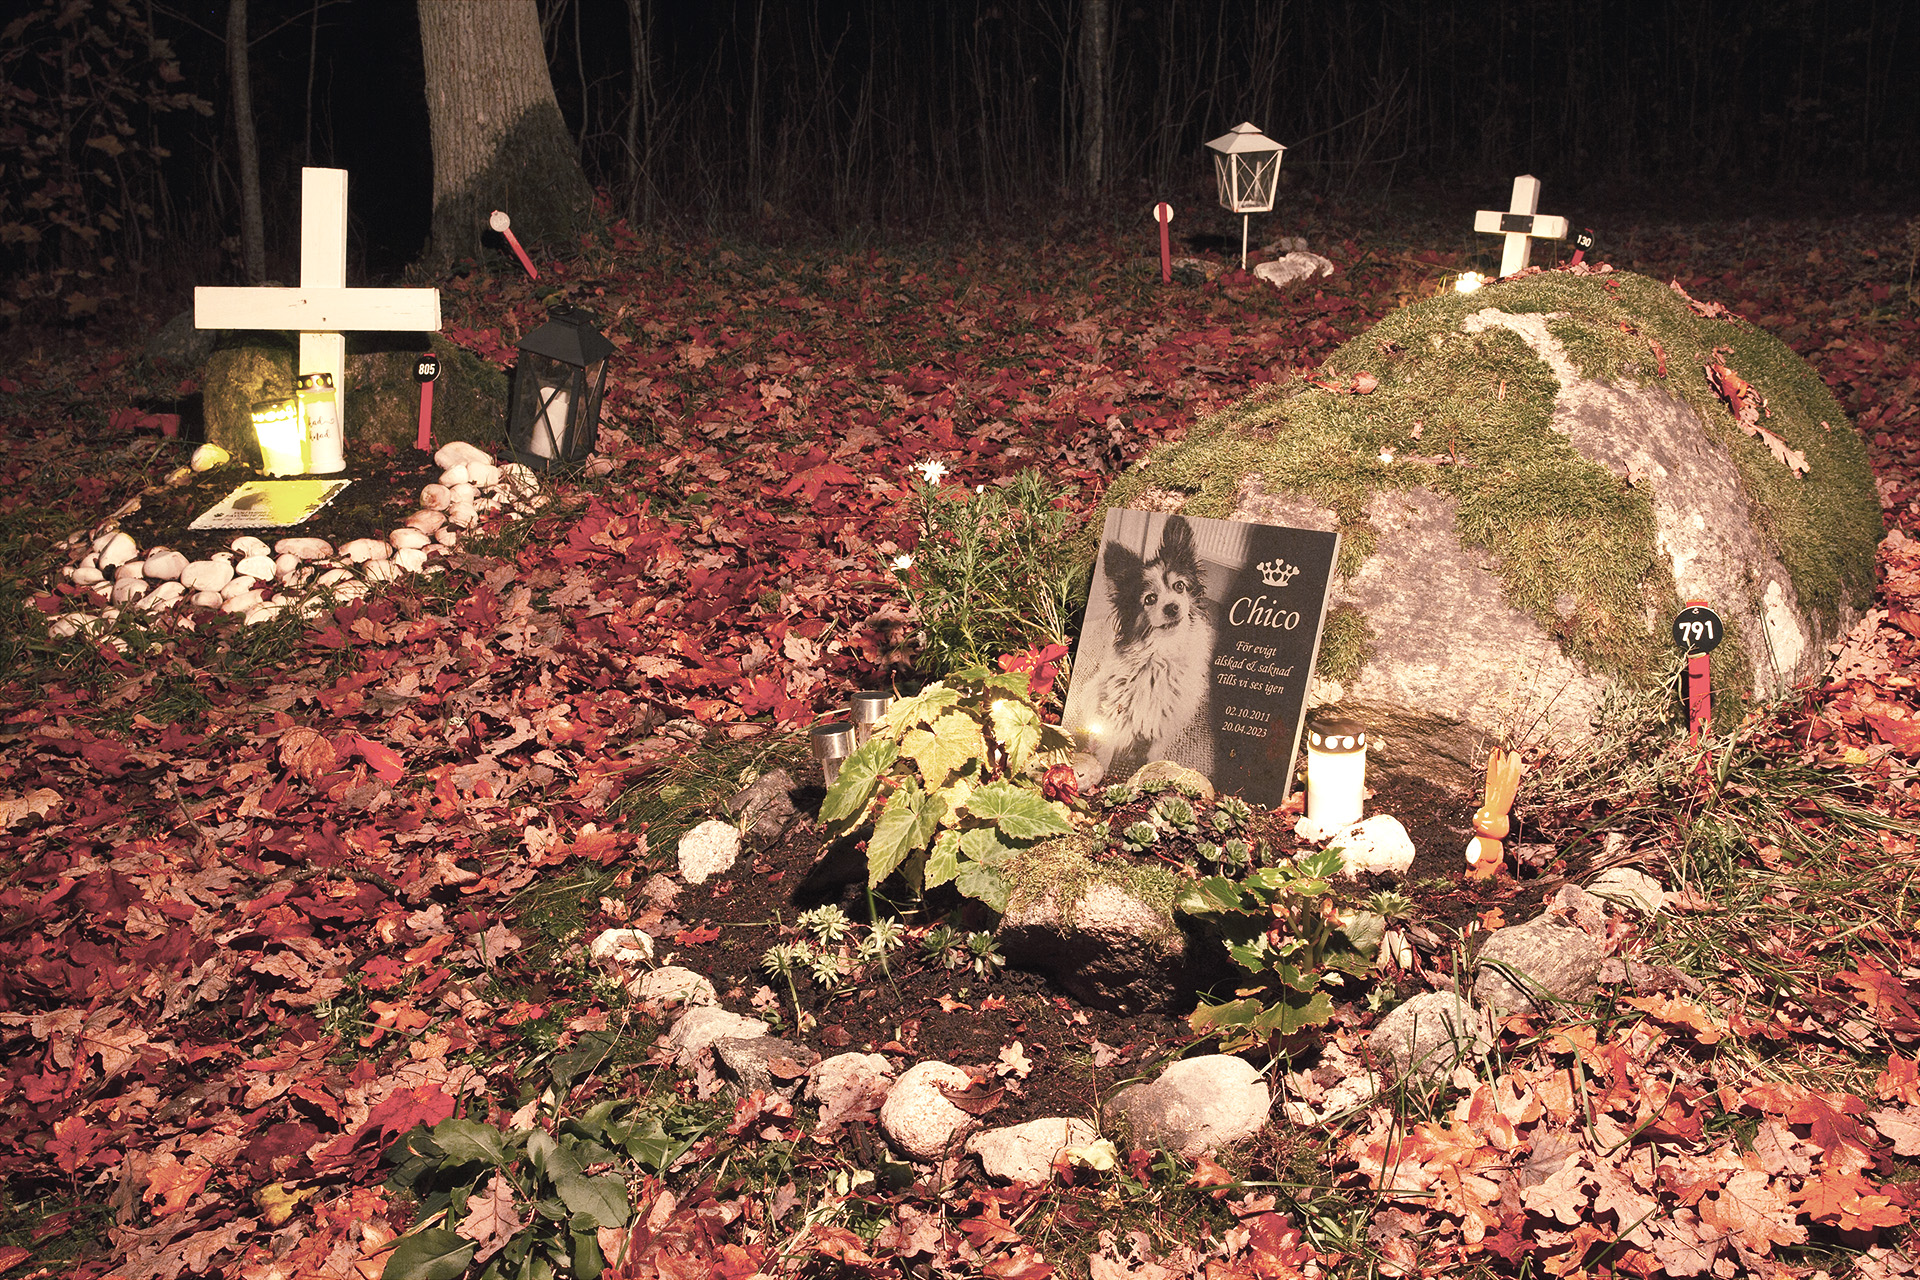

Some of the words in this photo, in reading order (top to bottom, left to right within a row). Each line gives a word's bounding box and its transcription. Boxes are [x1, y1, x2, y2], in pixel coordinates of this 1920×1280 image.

[1577, 234, 1592, 247] 130
[418, 363, 436, 375] 805
[1229, 595, 1300, 631] Chico
[1679, 620, 1714, 641] 791
[1236, 641, 1253, 652] För
[1253, 645, 1277, 659] evigt
[1214, 655, 1247, 670] älskad
[1246, 661, 1258, 672] &
[1258, 663, 1294, 677] saknad
[1217, 674, 1237, 686] Tills
[1239, 678, 1249, 688] vi
[1249, 681, 1263, 690] ses
[1264, 682, 1284, 696] igen
[1225, 705, 1271, 722] 02.10.2011
[1221, 721, 1268, 738] 20.04.2023
